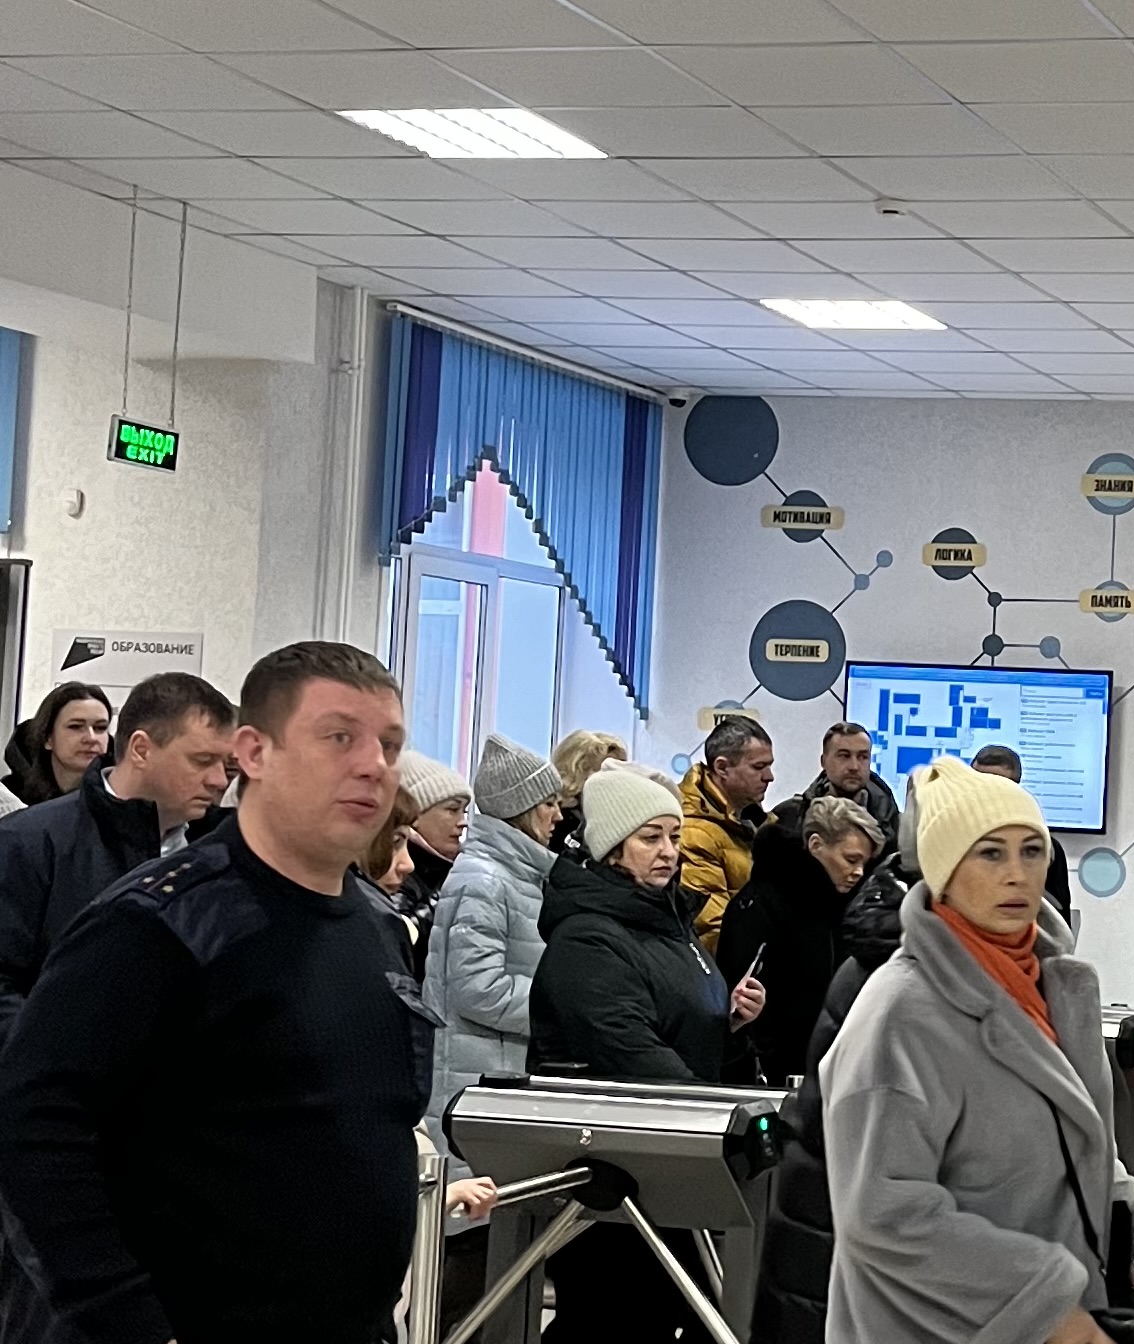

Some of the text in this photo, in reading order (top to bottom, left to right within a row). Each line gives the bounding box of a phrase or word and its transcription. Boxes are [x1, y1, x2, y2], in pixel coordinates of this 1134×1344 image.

[120, 425, 175, 455] ВЫХОД
[126, 445, 165, 465] EXIT
[1094, 479, 1134, 493] ЗНАНИЯ
[773, 510, 832, 525] МОТИВАЦИЯ
[934, 548, 973, 562] ЛОГИКА
[1091, 595, 1132, 608] ПАМЯТЬ
[111, 641, 195, 656] ОБРАЗОВАНИЕ
[774, 643, 821, 657] ТЕРПЕНИЕ
